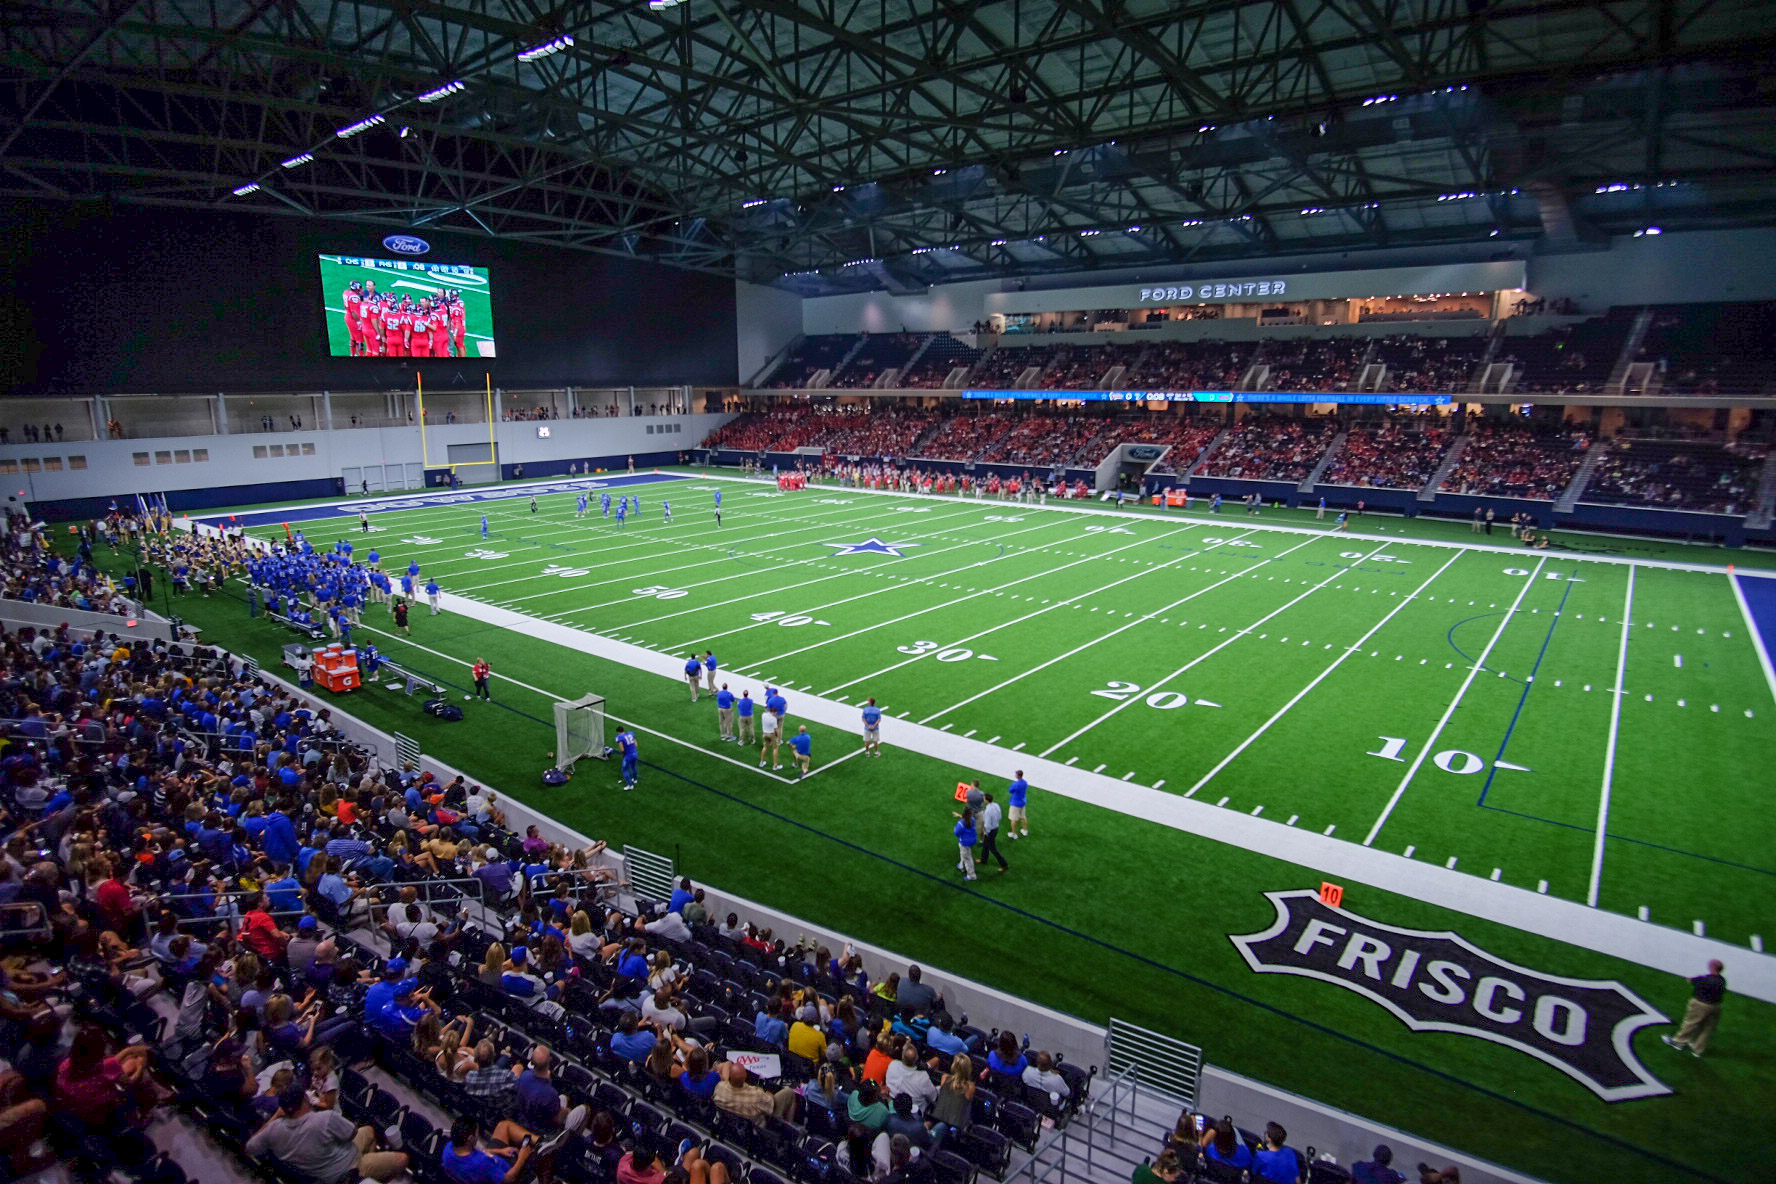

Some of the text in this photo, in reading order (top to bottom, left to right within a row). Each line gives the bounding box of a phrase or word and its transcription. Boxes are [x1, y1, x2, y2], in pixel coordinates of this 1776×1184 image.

[392, 239, 421, 252] Ford
[1140, 281, 1286, 301] FORD CENTER
[1201, 537, 1252, 548] 30
[1338, 552, 1397, 562] 20
[1502, 568, 1564, 580] 10
[632, 585, 689, 600] 50
[750, 611, 814, 626] 40
[896, 640, 974, 662] 30
[1090, 681, 1188, 710] 20
[624, 735, 635, 746] 12
[1366, 736, 1485, 774] 10
[1324, 886, 1338, 904] 10
[1294, 918, 1589, 1047] FRISCO
